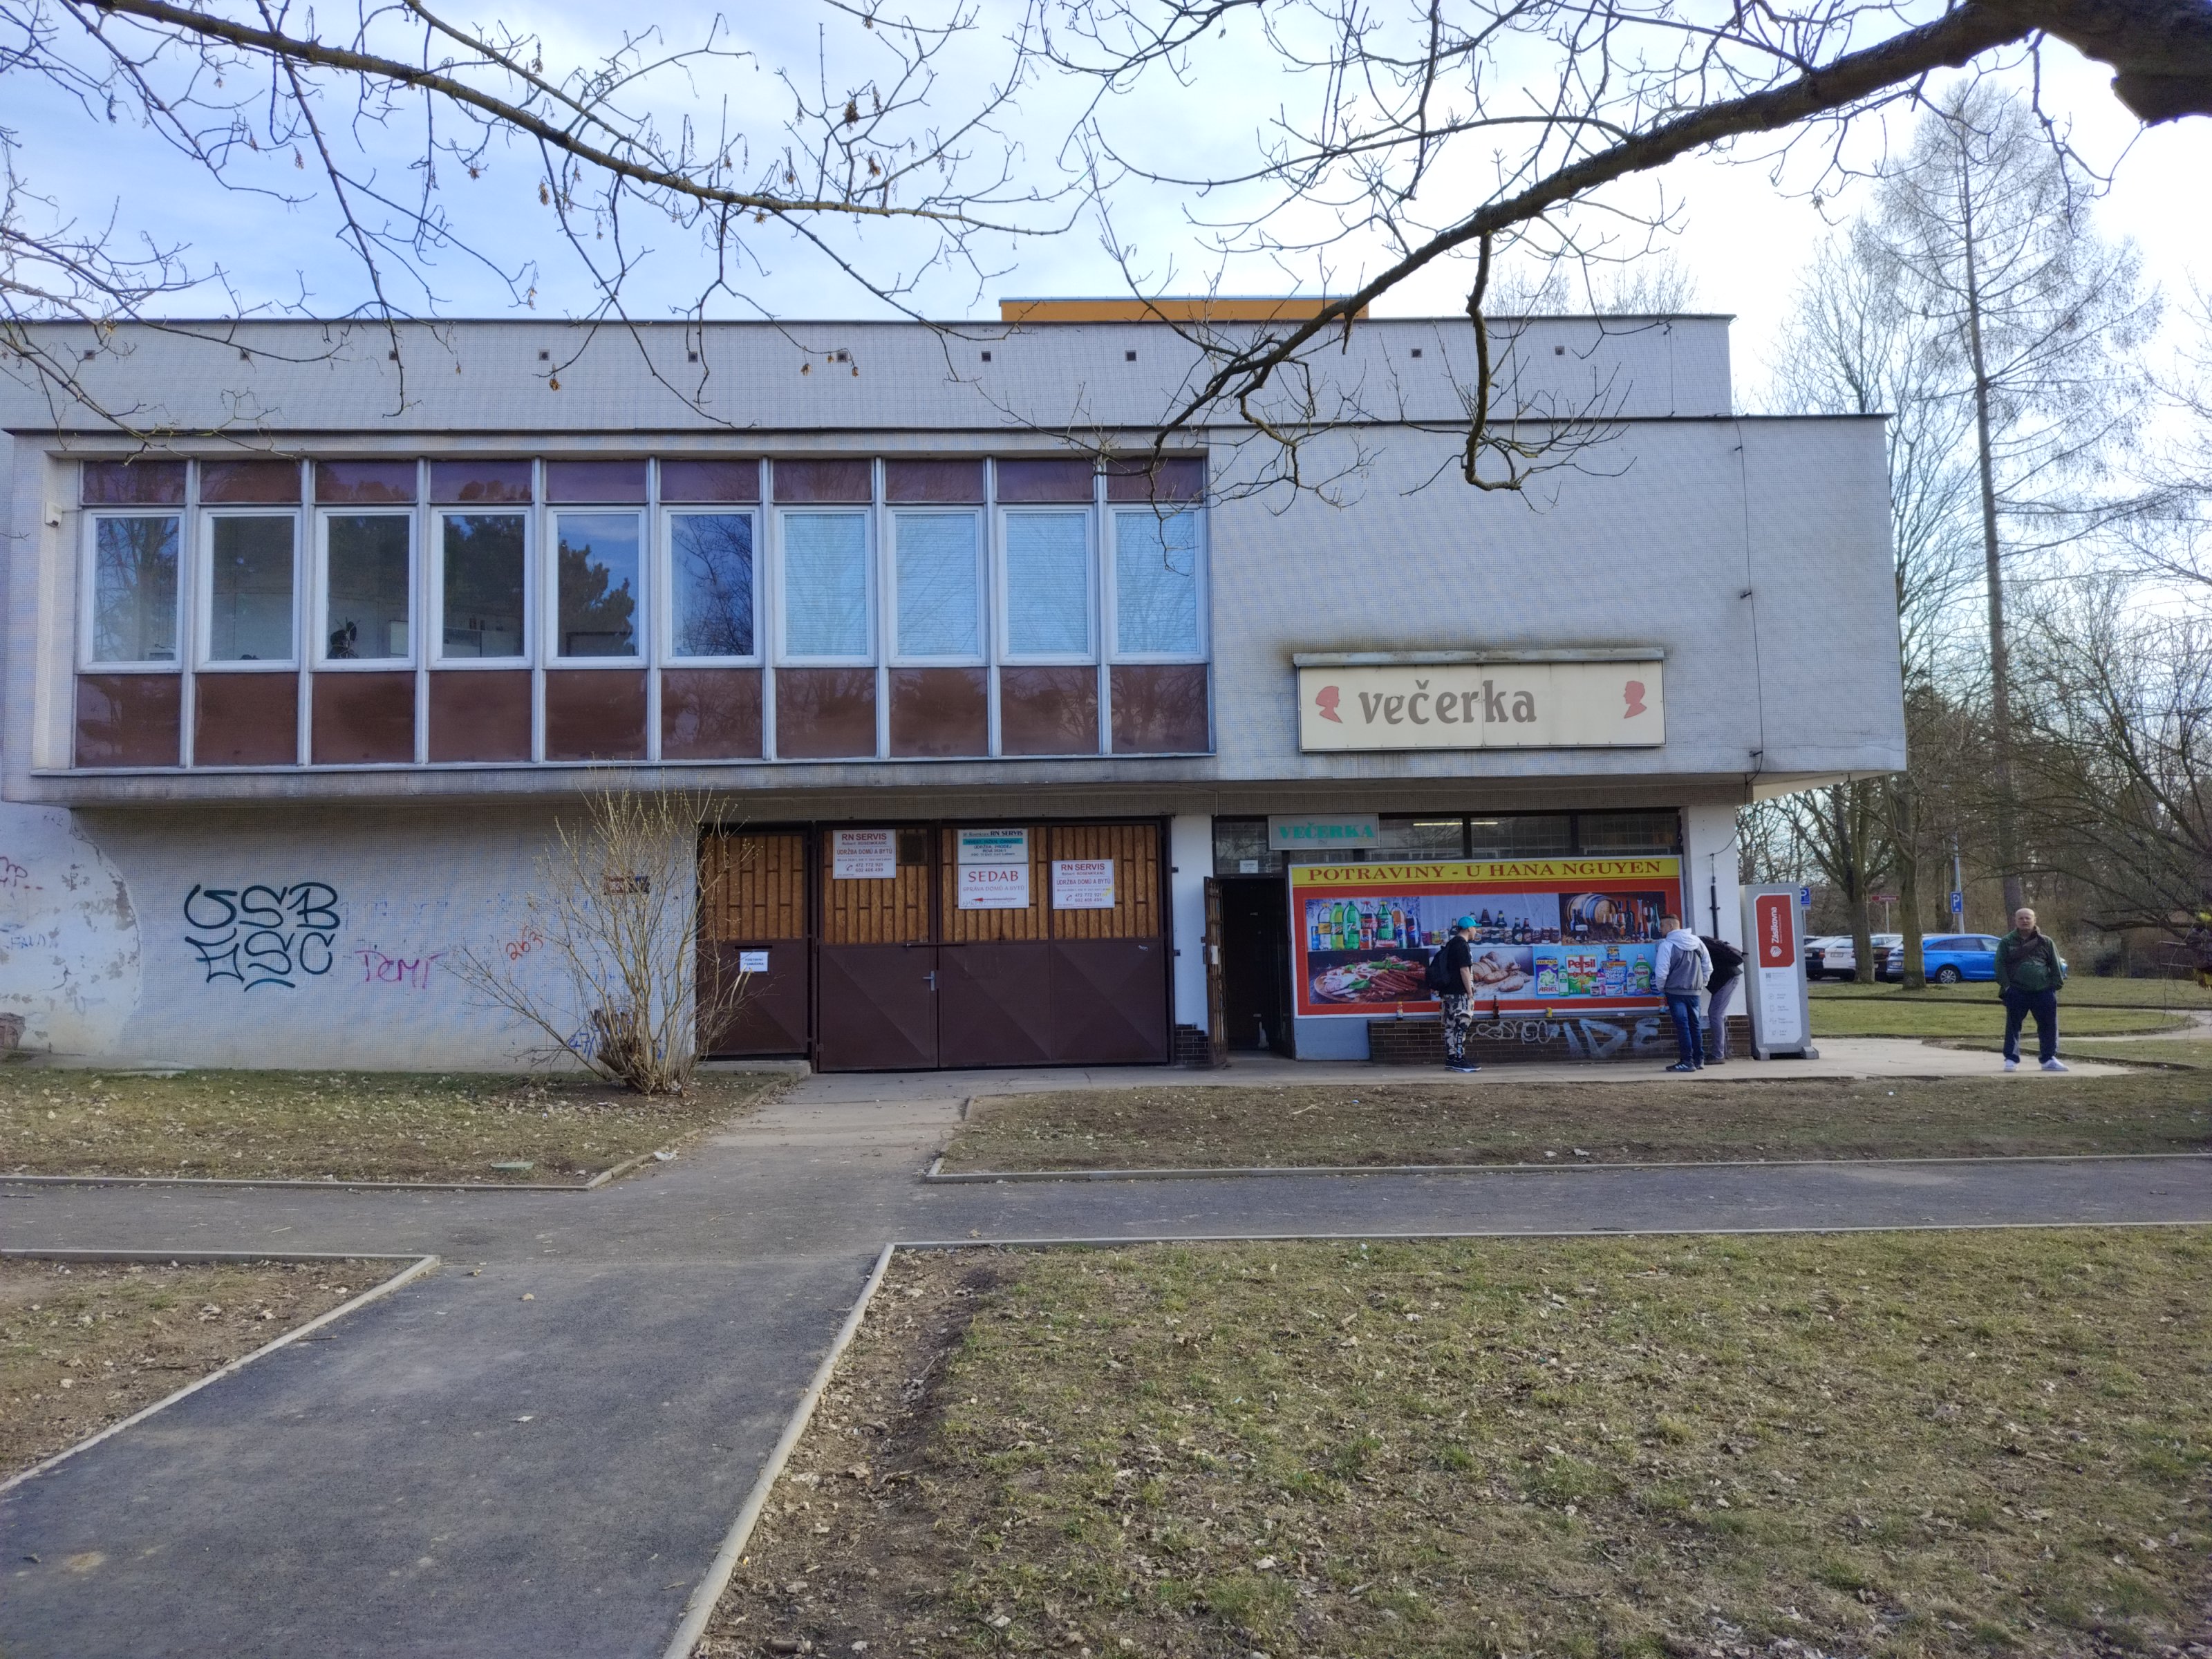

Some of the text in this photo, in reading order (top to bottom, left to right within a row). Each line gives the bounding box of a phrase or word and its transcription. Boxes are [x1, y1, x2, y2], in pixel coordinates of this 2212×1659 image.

[1358, 679, 1537, 724] večerka
[1279, 822, 1376, 839] VEČERKA
[1074, 863, 1105, 871] SERVIS
[1307, 865, 1446, 881] POTRAVINY
[1465, 865, 1482, 877] U
[1489, 863, 1555, 877] HANA
[1561, 861, 1661, 875] NGUYEN
[968, 870, 1019, 883] SEDAB
[1800, 889, 1807, 901] P
[1953, 894, 1960, 907] P
[1770, 906, 1779, 944] Zásilkovna
